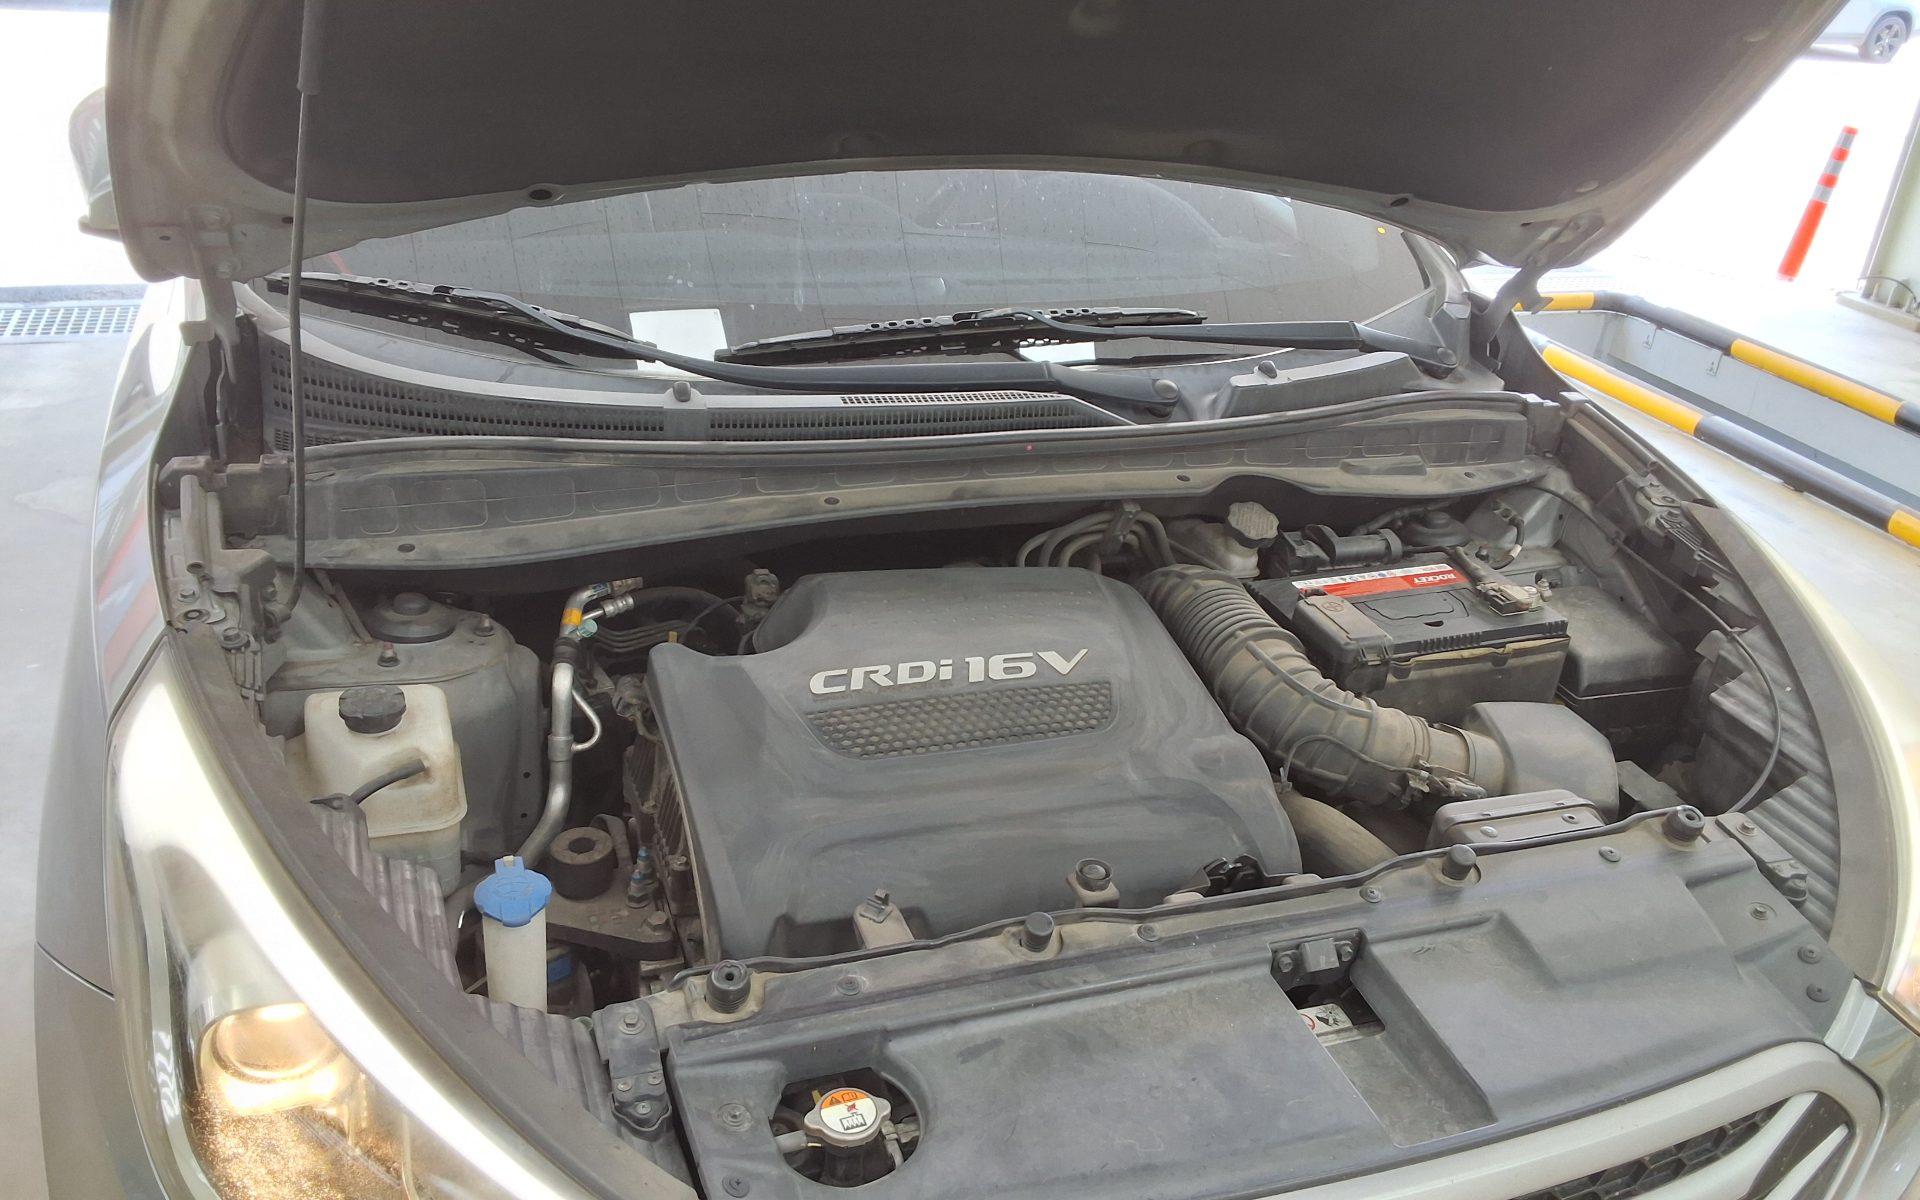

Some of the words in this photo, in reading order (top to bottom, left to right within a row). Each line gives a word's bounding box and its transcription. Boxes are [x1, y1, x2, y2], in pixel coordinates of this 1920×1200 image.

[1414, 573, 1456, 583] ROCKET
[809, 659, 952, 694] CRDi
[965, 649, 1088, 682] 16V
